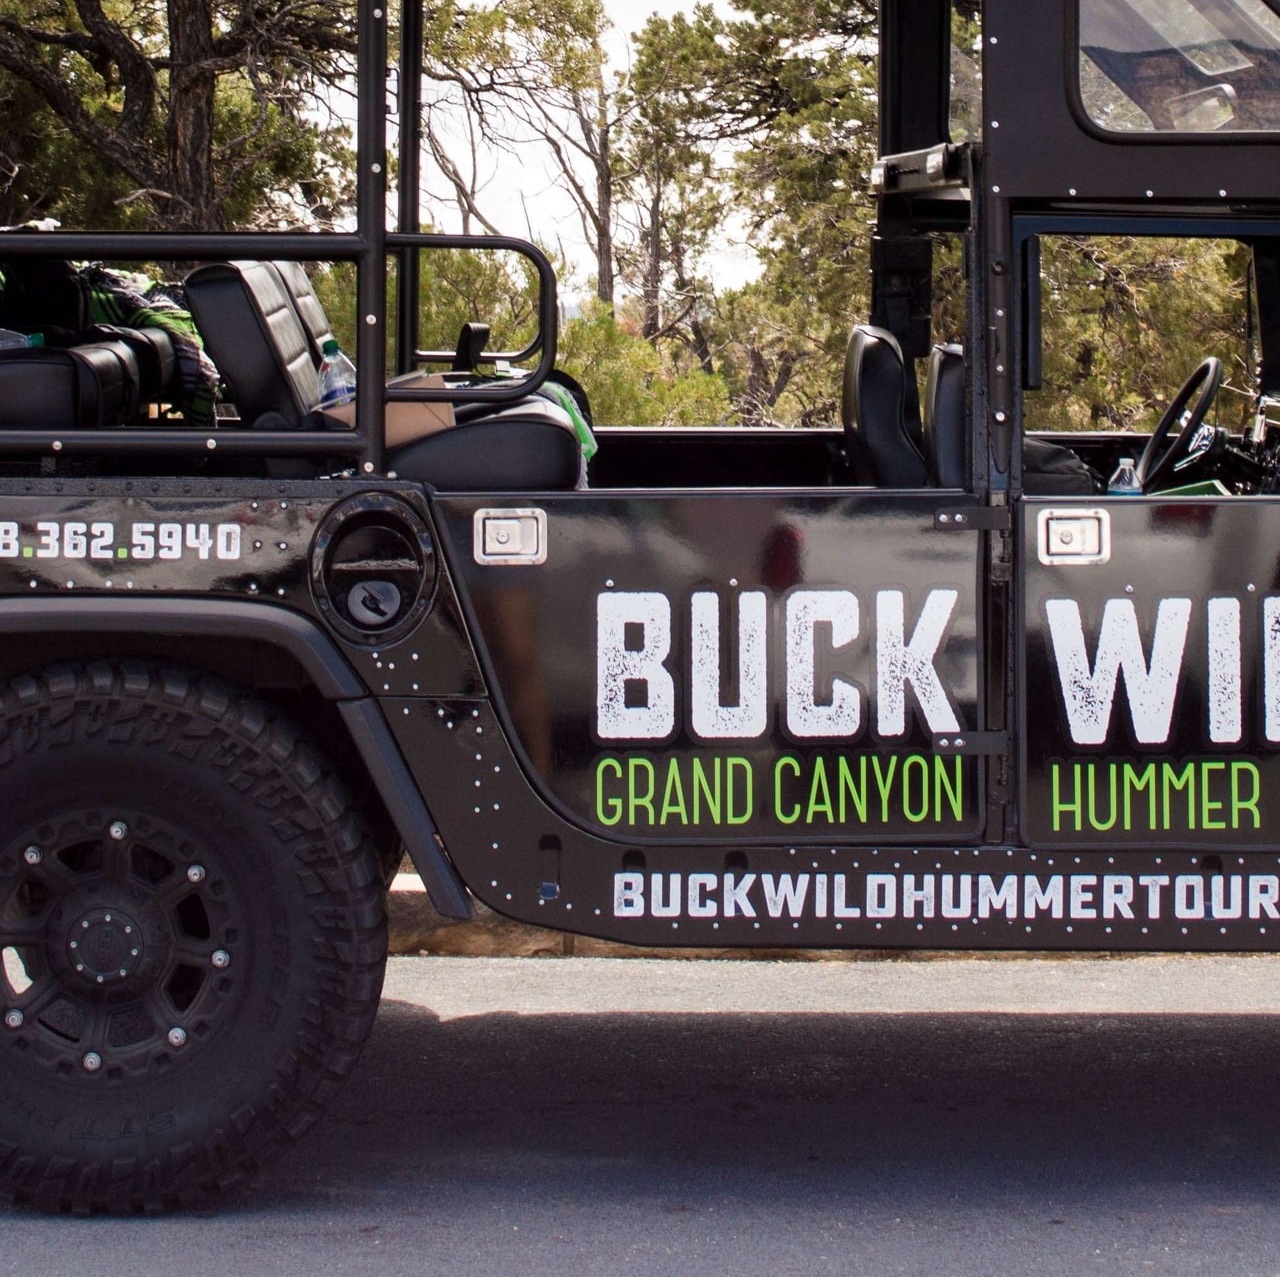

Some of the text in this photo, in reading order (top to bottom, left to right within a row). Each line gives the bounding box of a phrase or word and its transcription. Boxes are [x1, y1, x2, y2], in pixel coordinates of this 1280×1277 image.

[597, 589, 962, 738] BUCK
[597, 757, 752, 825] GRAND
[775, 755, 962, 823] CANYON
[1053, 762, 1260, 830] HUMMER
